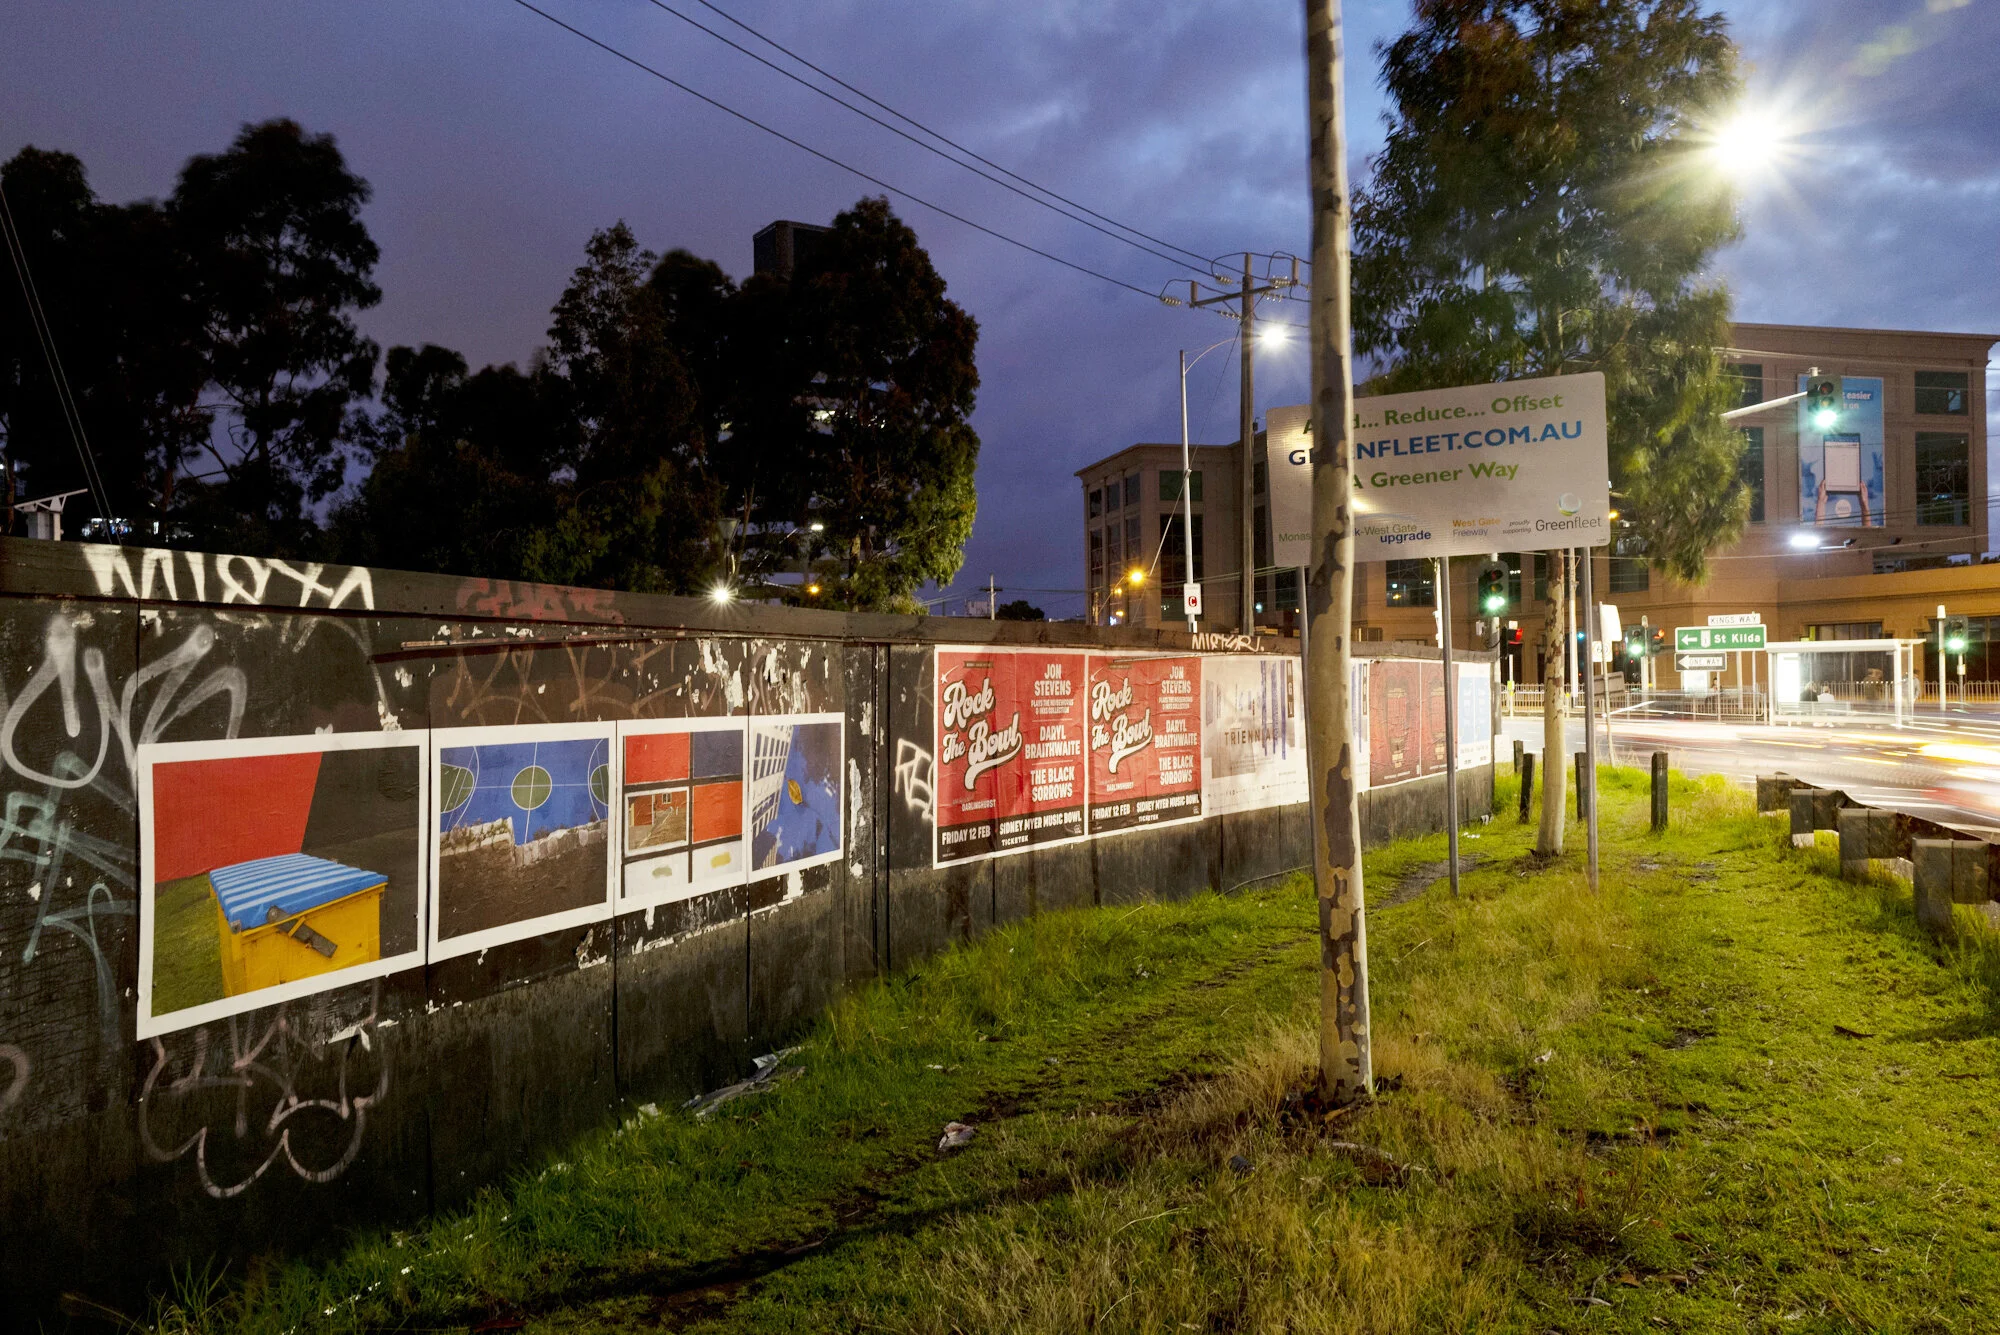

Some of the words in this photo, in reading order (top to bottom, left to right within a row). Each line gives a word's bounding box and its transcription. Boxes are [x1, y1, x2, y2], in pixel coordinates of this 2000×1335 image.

[1385, 402, 1486, 425] Reduce...
[1491, 393, 1564, 414] Offset
[1371, 467, 1463, 488] Greener
[1468, 461, 1520, 481] Way
[1392, 523, 1417, 534] Gate
[1478, 518, 1501, 526] Gate
[1508, 519, 1531, 527] proudly
[1535, 516, 1602, 532] Greenfleet
[1380, 530, 1432, 545] upgrade
[1452, 529, 1489, 537] Freeway
[1502, 527, 1532, 535] supporting
[1739, 614, 1757, 622] WAY
[1714, 634, 1726, 643] St
[1731, 633, 1761, 643] Kilda
[1044, 664, 1062, 679] JON
[1169, 666, 1184, 680] JON
[1034, 680, 1071, 696] STEVENS
[1161, 680, 1191, 694] STEVENS
[943, 677, 995, 729] Rock
[1092, 678, 1132, 721] Rock
[1040, 725, 1066, 741] DARYL
[1165, 719, 1187, 733] DARYL
[1092, 724, 1110, 751] The
[1154, 732, 1198, 749] BRAITHWAITE
[942, 732, 965, 764] The
[1025, 740, 1081, 759] BRAITHWAITE
[1158, 757, 1171, 771] THE
[1172, 755, 1194, 769] BLACK
[1031, 769, 1047, 785] THE
[1048, 766, 1075, 783] BLACK
[1159, 769, 1193, 786] SORROWS
[1032, 783, 1073, 803] SORROWS
[1092, 806, 1112, 820] FRIDAY
[1112, 805, 1120, 817] 12
[1120, 803, 1131, 816] FEB
[1136, 800, 1155, 813] SIDNEY
[1155, 798, 1169, 810] MYER
[1169, 796, 1185, 808] MUSIC
[1185, 794, 1200, 805] BOWL
[942, 829, 968, 845] FRIDAY
[969, 827, 977, 840] 12
[978, 825, 991, 838] FEB
[1000, 819, 1023, 835] SIDNEY
[1024, 817, 1042, 831] MYER
[1043, 813, 1063, 828] MUSIC
[1064, 810, 1082, 824] BOWL
[1001, 835, 1029, 847] TICKETEK
